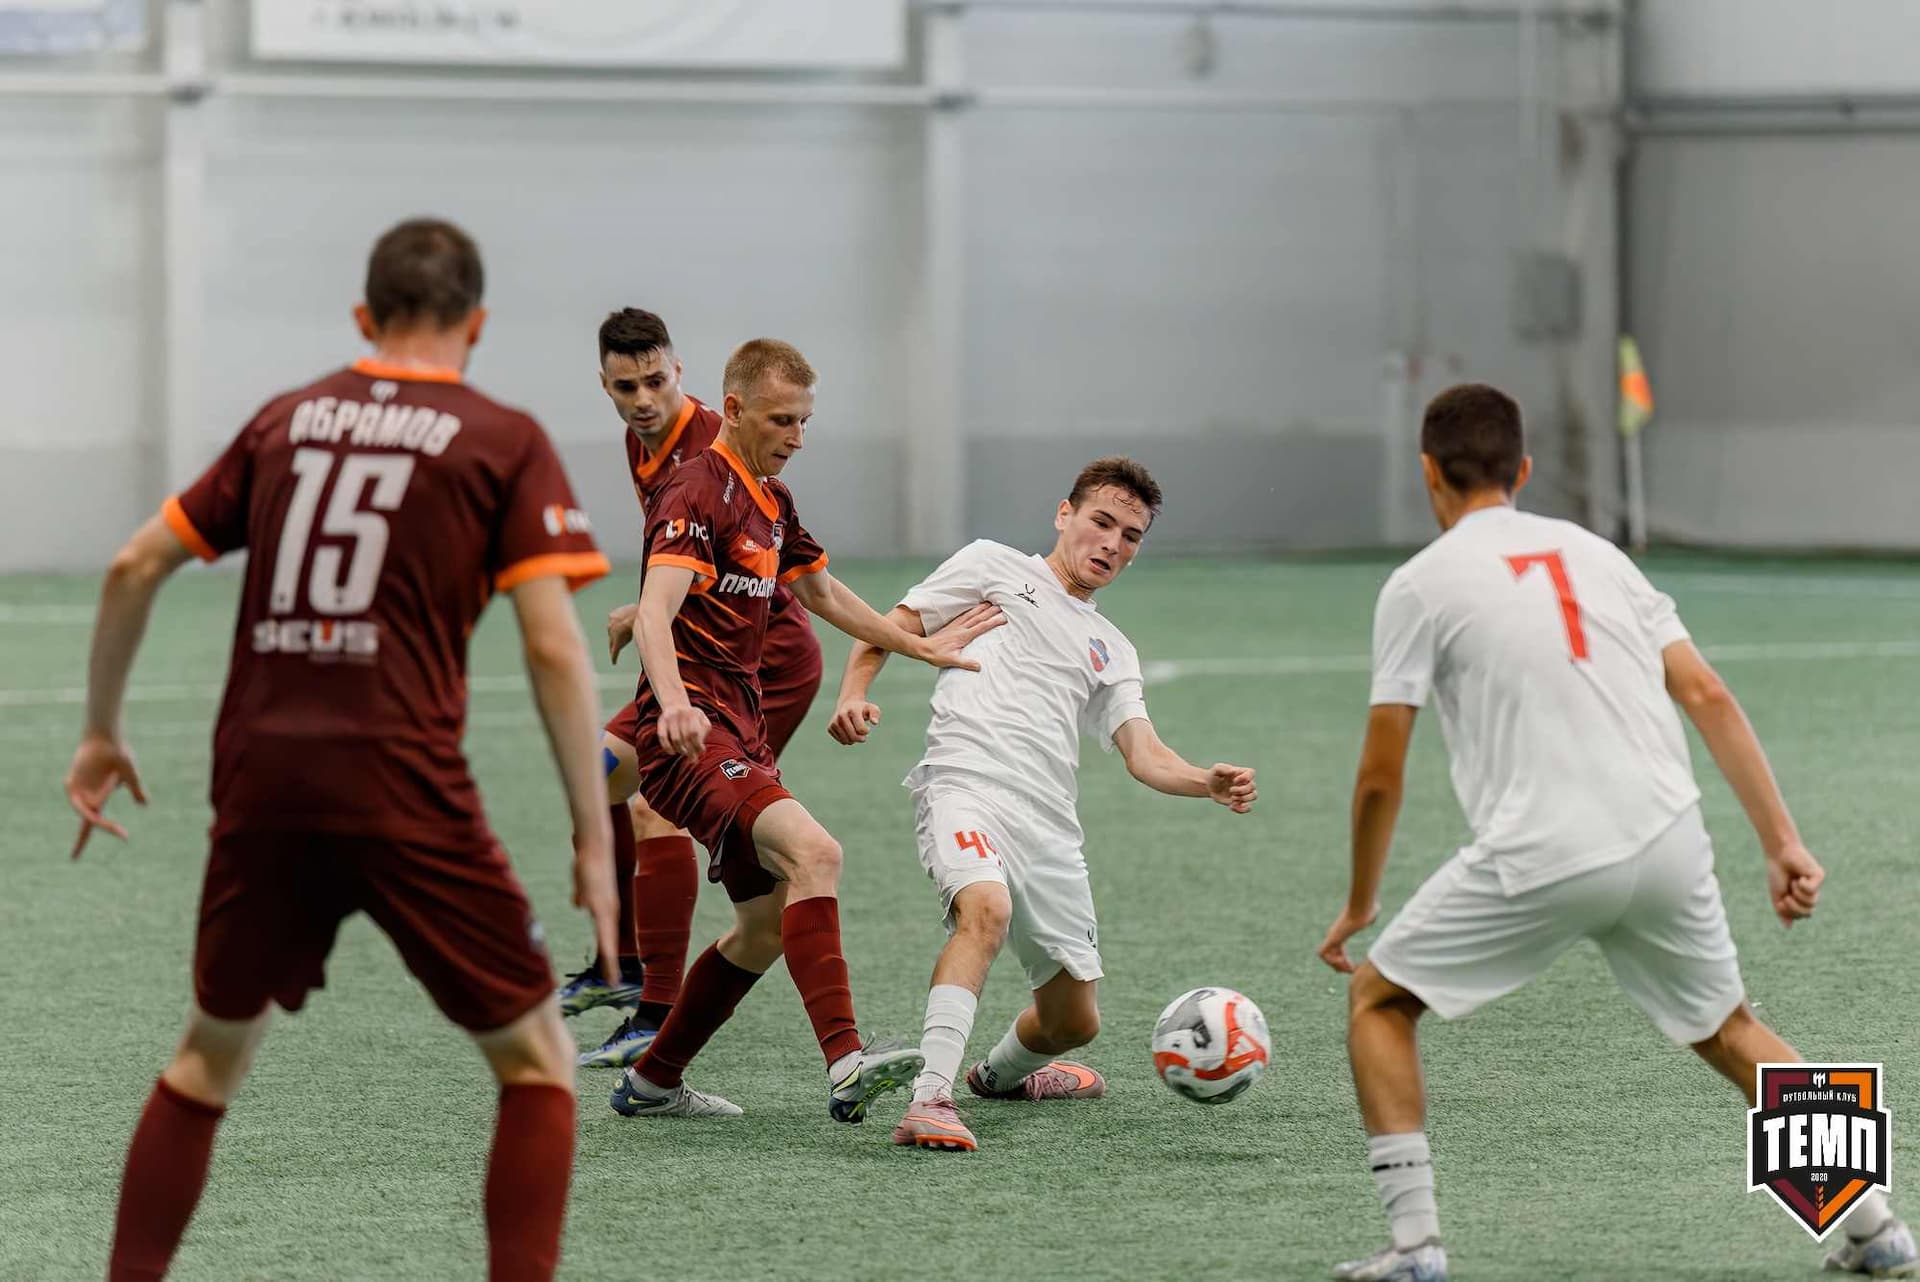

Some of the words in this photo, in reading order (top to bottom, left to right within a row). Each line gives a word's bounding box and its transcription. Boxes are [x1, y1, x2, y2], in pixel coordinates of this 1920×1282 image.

[289, 397, 461, 456] АБРАМОВ
[270, 448, 415, 615] 15
[1505, 550, 1590, 662] 7
